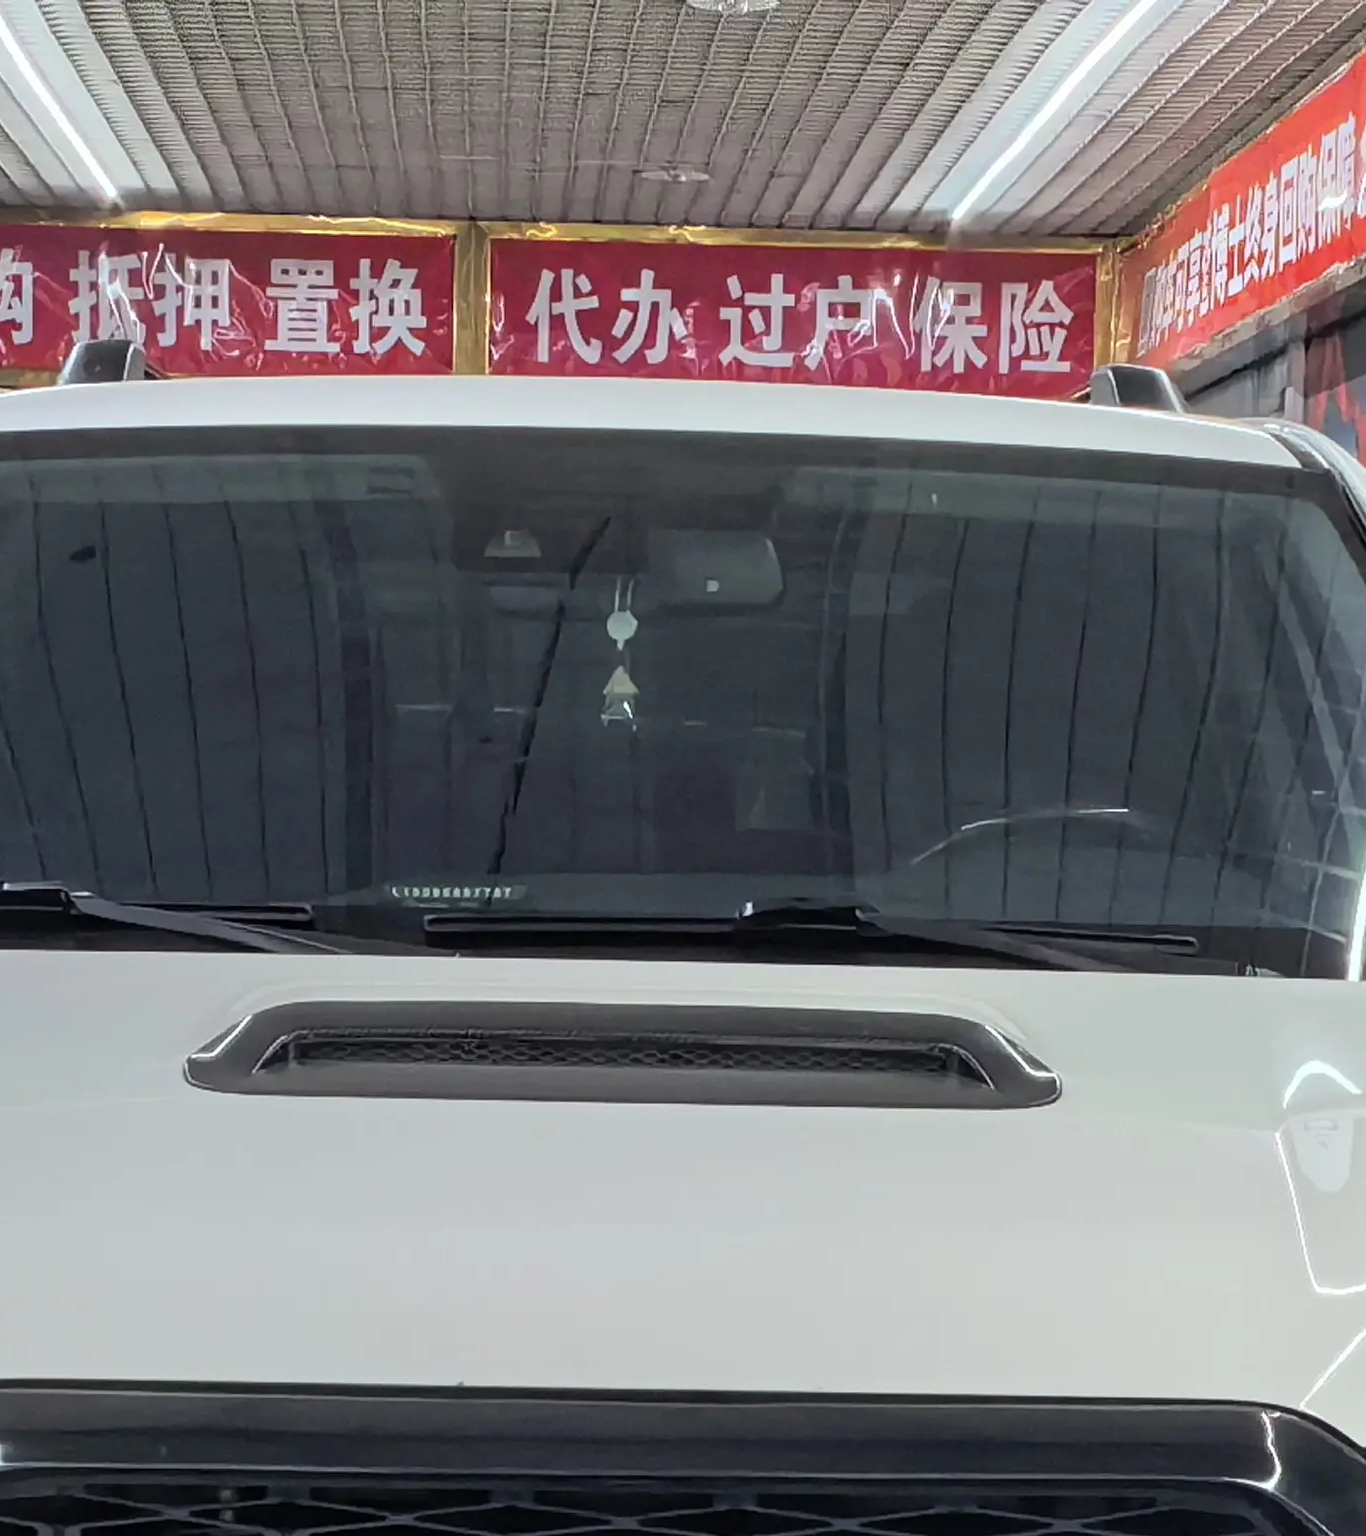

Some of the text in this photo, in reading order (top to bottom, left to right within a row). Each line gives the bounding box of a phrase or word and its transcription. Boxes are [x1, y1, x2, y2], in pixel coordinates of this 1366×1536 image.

[68, 250, 231, 350] 抵押
[264, 258, 427, 356] 置换
[525, 268, 1075, 375] 代办 过户 保险
